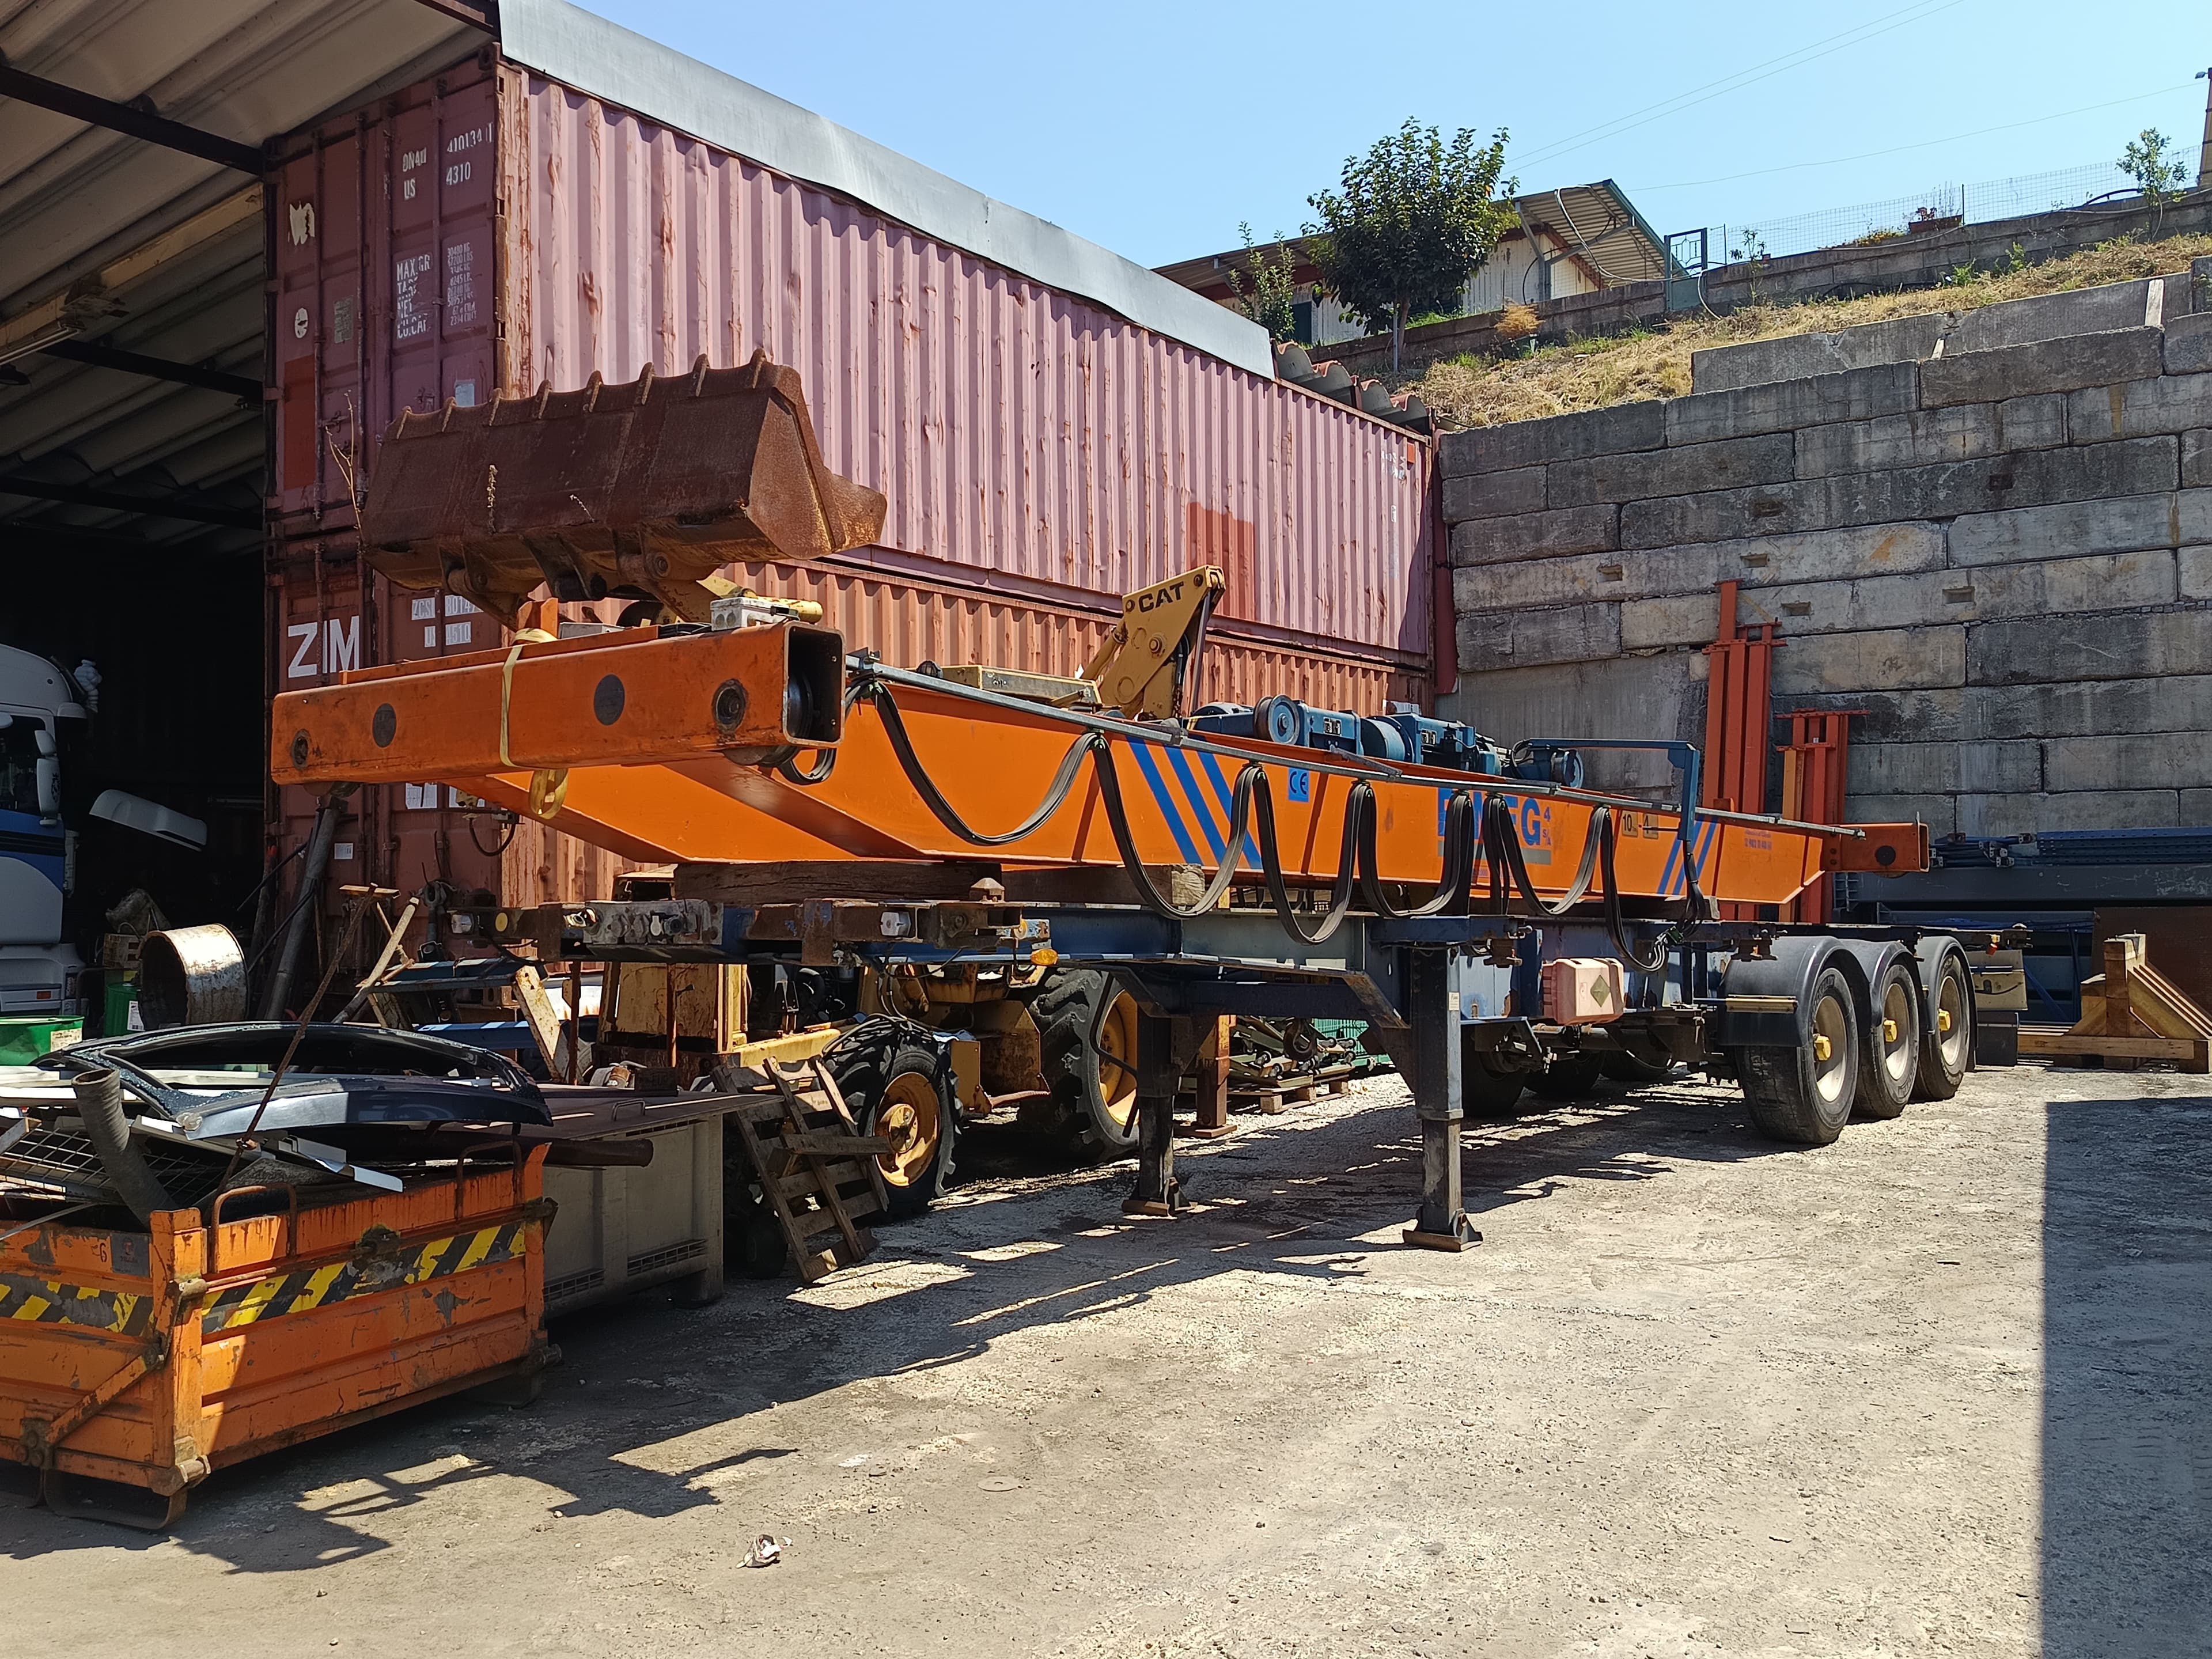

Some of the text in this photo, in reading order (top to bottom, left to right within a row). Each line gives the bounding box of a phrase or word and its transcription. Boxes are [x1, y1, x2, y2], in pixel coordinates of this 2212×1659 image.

[404, 161, 471, 200] US 4310
[1138, 581, 1185, 613] CAT
[287, 615, 359, 678] ZIM
[1289, 770, 1308, 796] CE
[1622, 813, 1633, 832] 10
